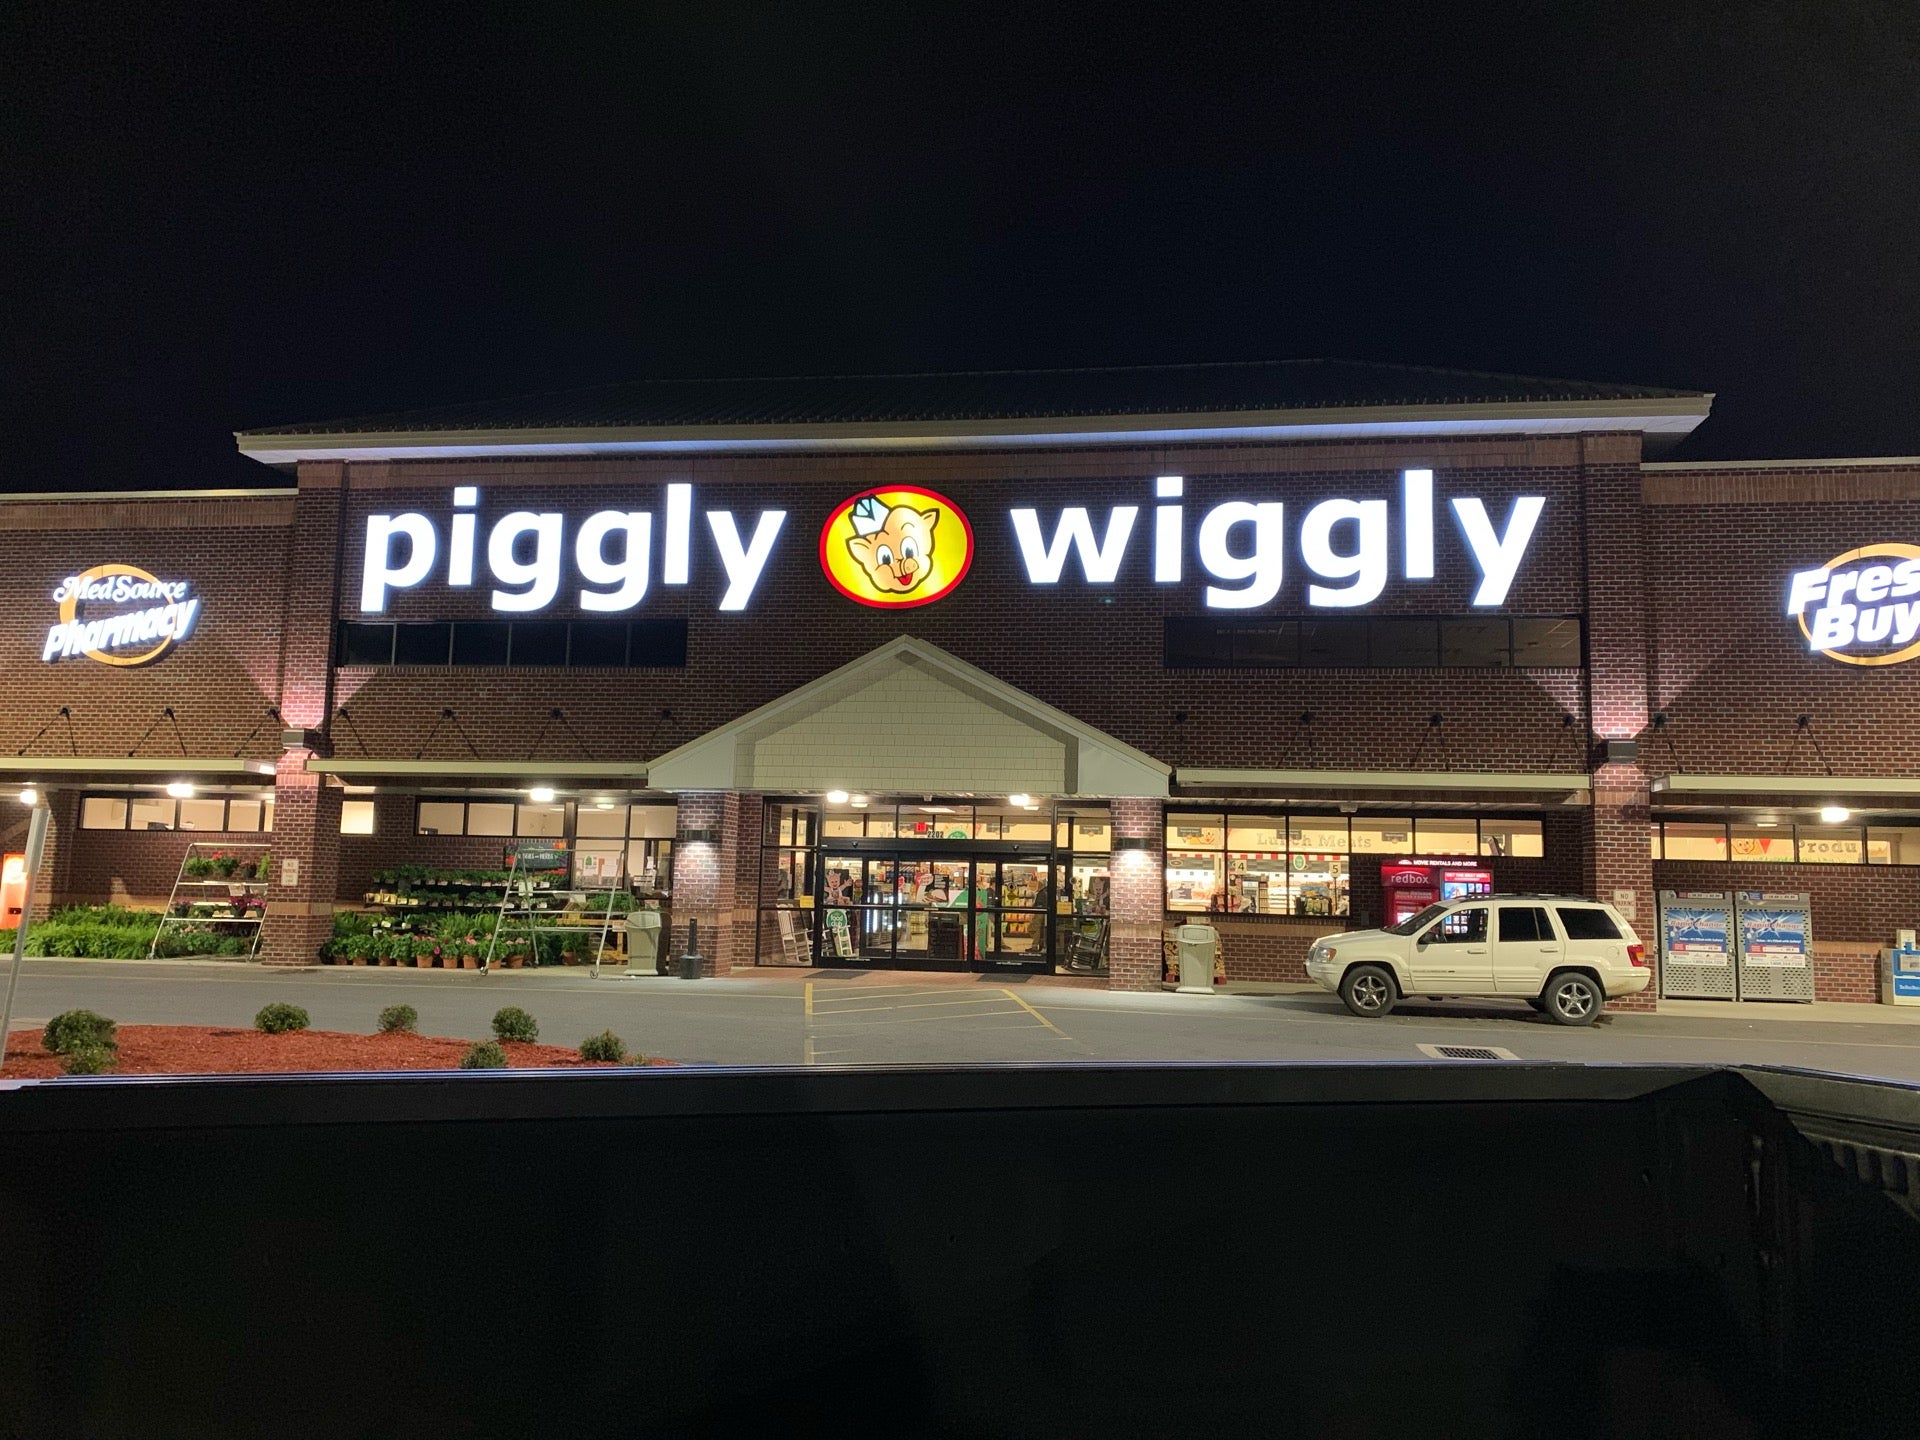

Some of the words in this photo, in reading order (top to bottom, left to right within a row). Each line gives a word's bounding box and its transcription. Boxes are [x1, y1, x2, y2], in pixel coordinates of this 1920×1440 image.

[361, 483, 787, 612] piggly
[1010, 469, 1546, 608] wiggly
[927, 831, 944, 839] 2202
[1256, 832, 1312, 847] Luch
[1237, 862, 1245, 872] 4
[1332, 864, 1339, 874] 5
[1391, 873, 1429, 884] redbox
